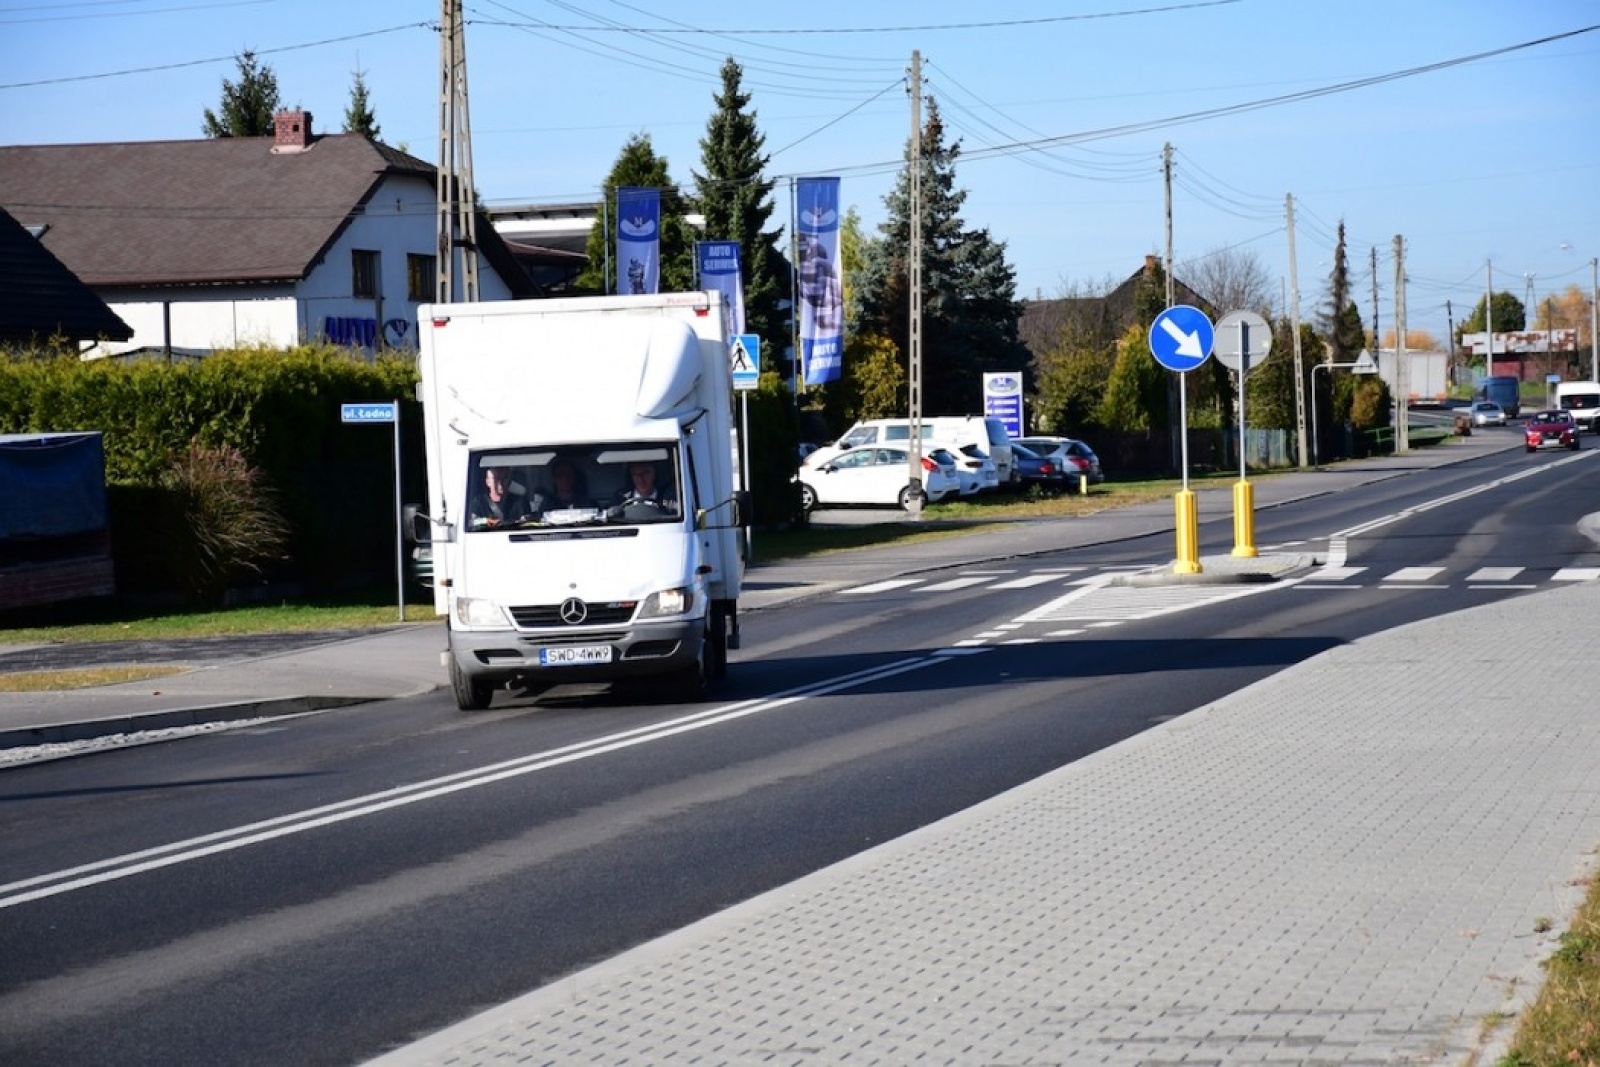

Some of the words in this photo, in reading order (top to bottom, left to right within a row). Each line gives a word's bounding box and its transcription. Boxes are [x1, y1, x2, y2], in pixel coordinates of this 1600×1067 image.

[709, 245, 731, 257] AUTO
[345, 408, 358, 419] ul.
[549, 648, 575, 662] SWD
